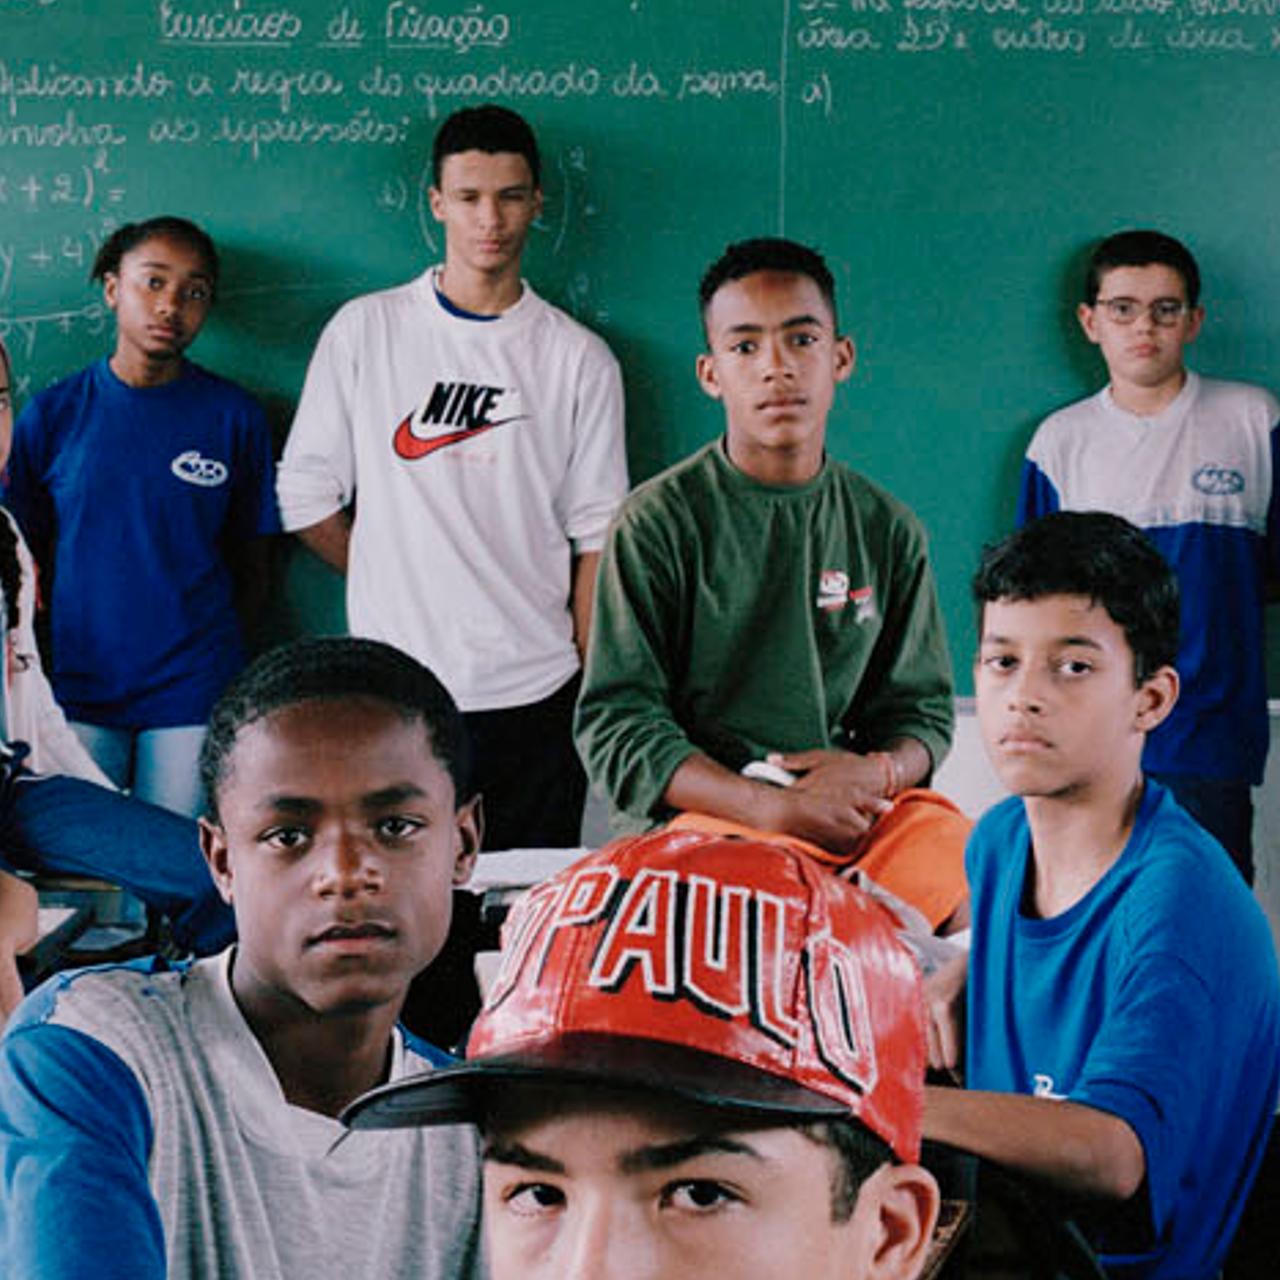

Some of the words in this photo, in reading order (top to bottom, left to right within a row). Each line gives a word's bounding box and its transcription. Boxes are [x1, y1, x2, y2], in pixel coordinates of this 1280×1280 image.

[414, 63, 601, 118] quadrado
[421, 381, 505, 431] NIKE
[534, 863, 878, 1094] PAULO
